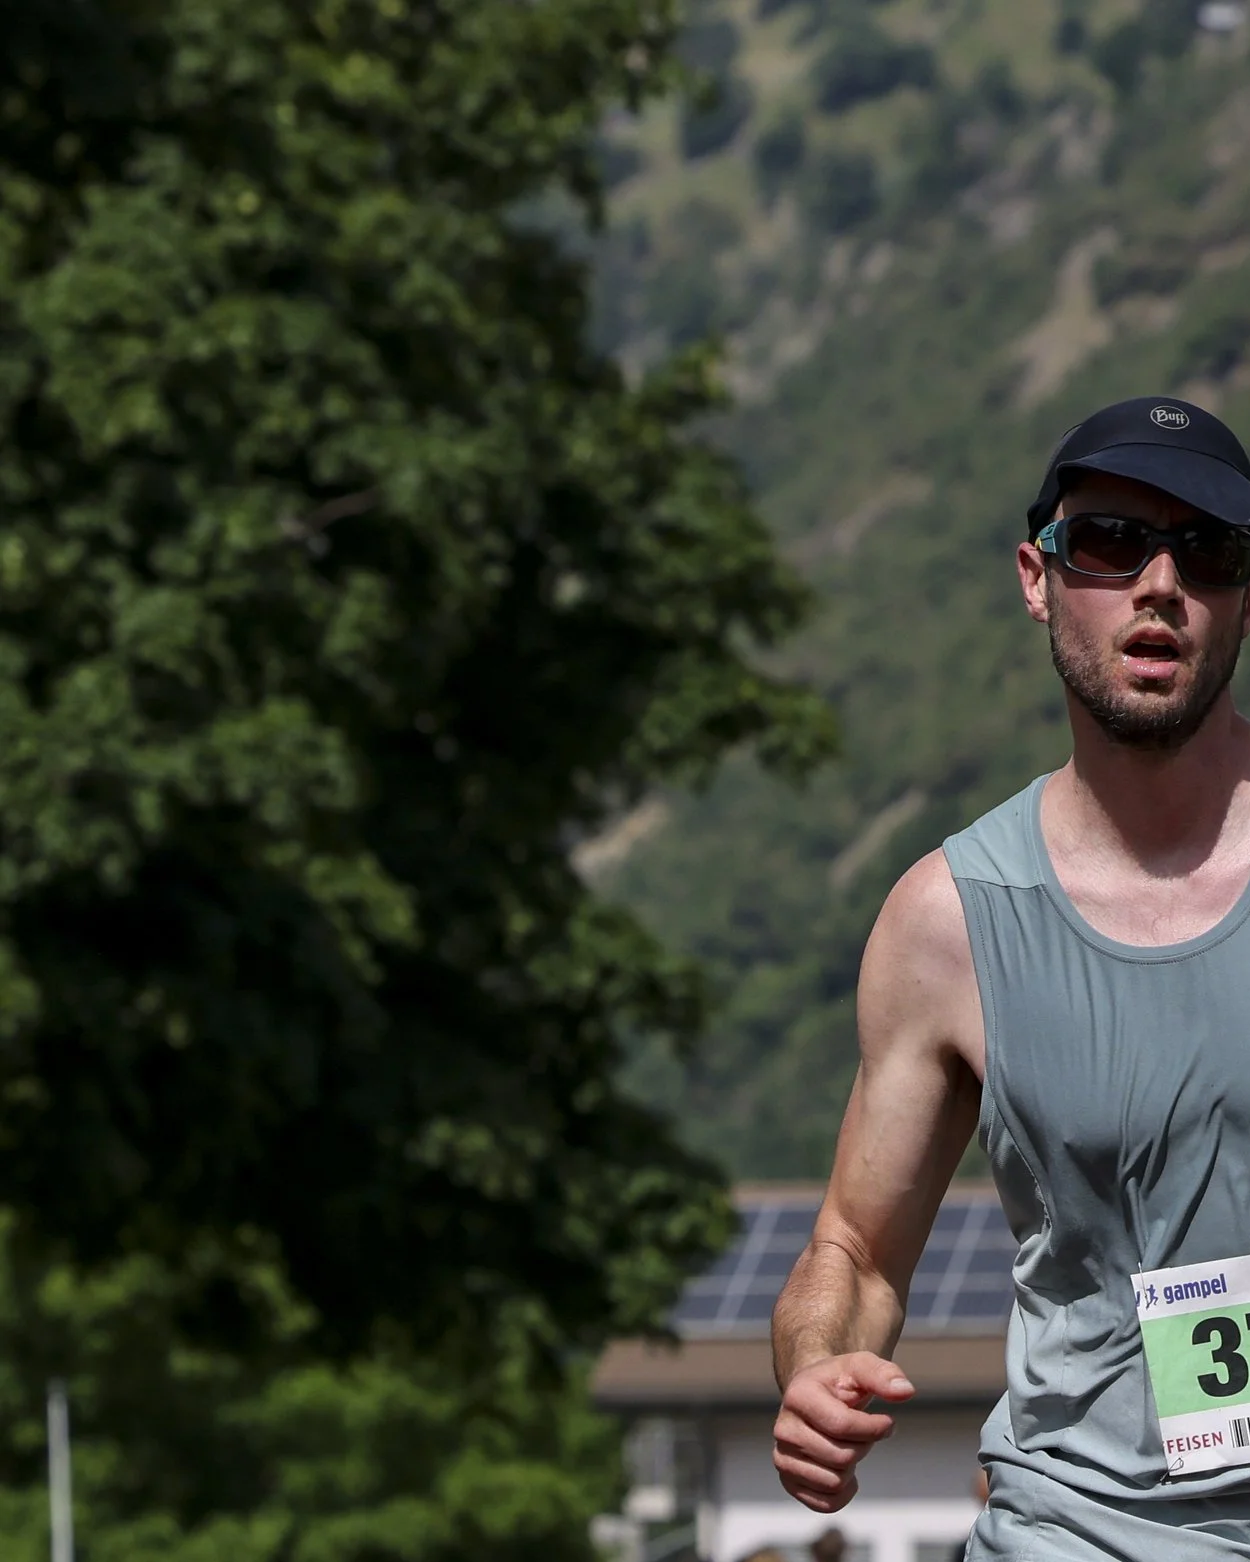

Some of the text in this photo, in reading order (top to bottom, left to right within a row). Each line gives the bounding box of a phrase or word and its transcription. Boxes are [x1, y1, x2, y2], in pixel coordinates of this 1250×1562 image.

[1155, 410, 1184, 424] Buff
[1164, 1273, 1227, 1303] gampel
[1163, 1432, 1222, 1454] FEISEN
